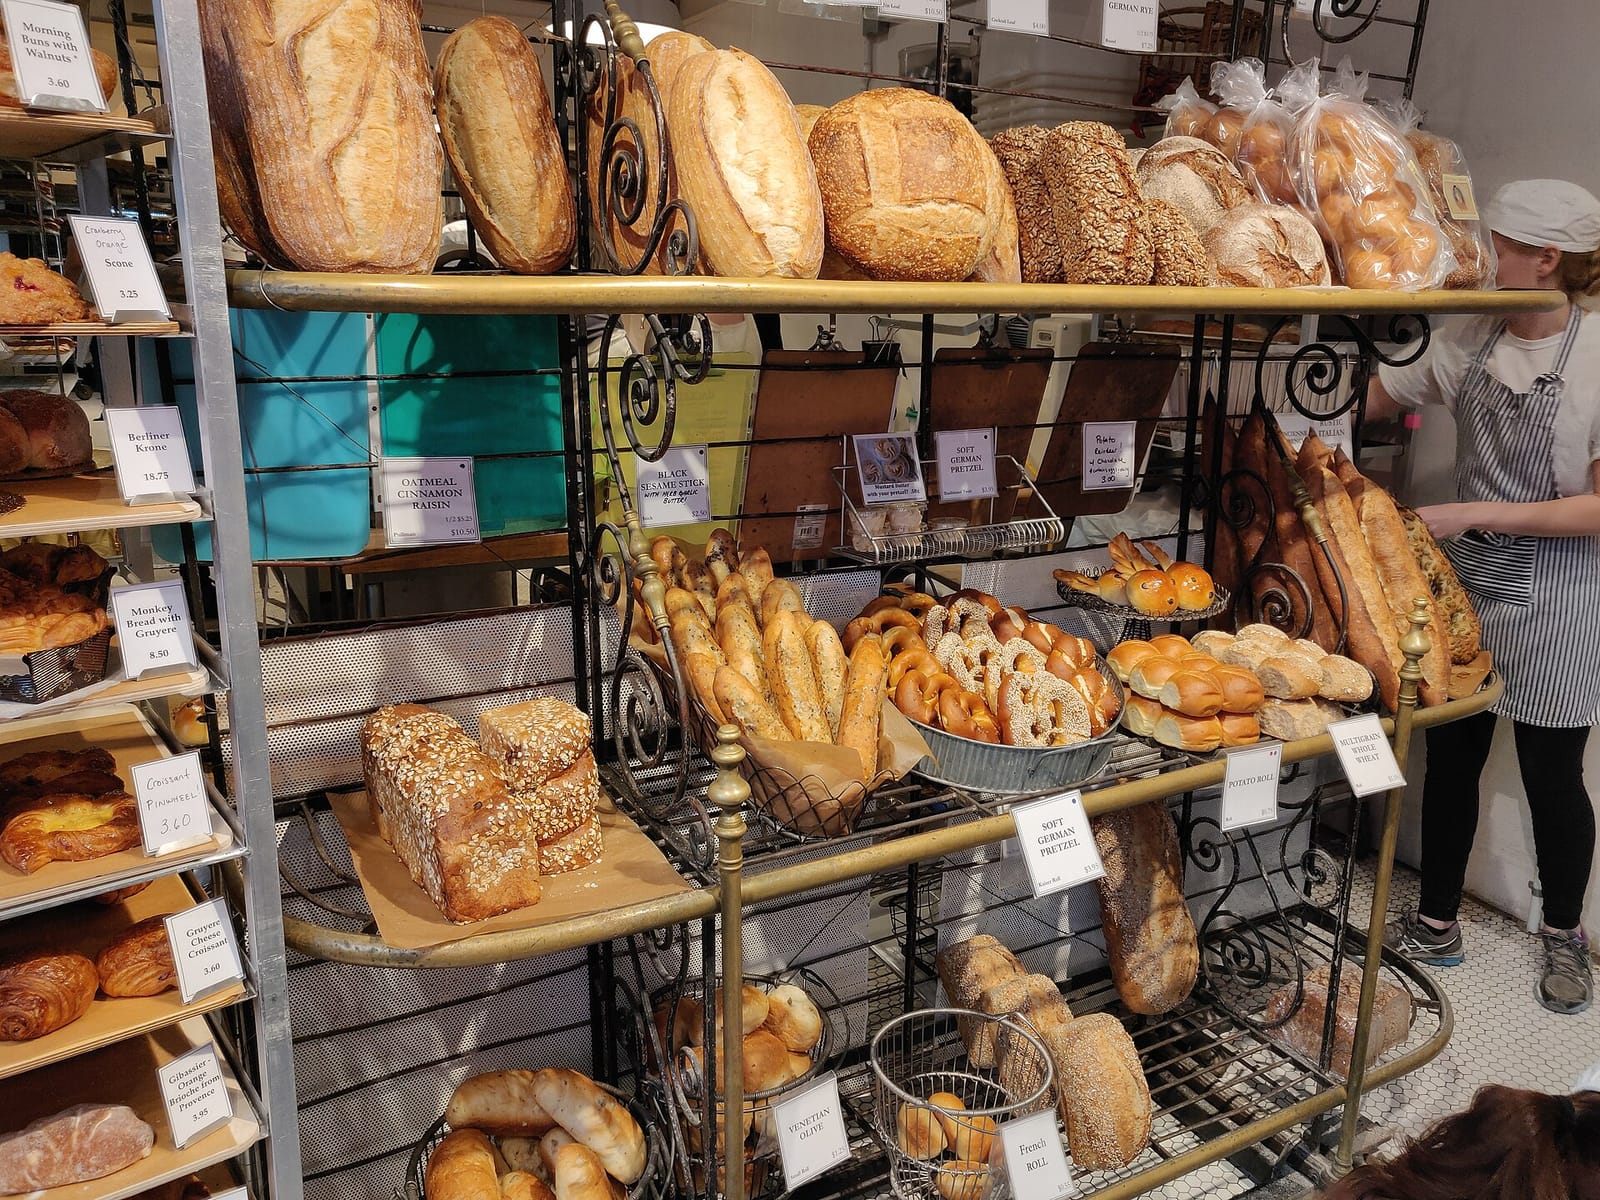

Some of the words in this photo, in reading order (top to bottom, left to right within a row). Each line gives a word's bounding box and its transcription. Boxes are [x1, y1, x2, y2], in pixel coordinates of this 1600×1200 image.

[924, 8, 943, 16] $10.50
[1108, 1, 1139, 13] GERMAN
[1139, 7, 1154, 15] RYE
[23, 22, 72, 41] Morning
[21, 34, 50, 47] Buns
[52, 40, 78, 52] with
[47, 77, 70, 88] 3.60
[95, 239, 128, 254] Orange
[104, 258, 134, 268] Scone
[119, 290, 139, 299] 3.25
[1319, 418, 1343, 427] RUSTIC
[128, 431, 170, 442] Berliner
[1319, 428, 1345, 437] ITALIAN
[135, 444, 167, 453] Krone
[956, 446, 975, 454] SOFT
[950, 454, 982, 464] GERMAN
[658, 469, 688, 479] BLACK
[950, 464, 984, 473] PRETZEL
[144, 471, 169, 481] 18.75
[401, 477, 457, 487] OATMEAL
[640, 480, 677, 491] SESAME
[678, 478, 705, 488] STICK
[397, 488, 463, 499] CINNAMON
[412, 501, 451, 510] RAISIN
[450, 527, 475, 537] $10.50
[131, 604, 173, 617] Monkey
[126, 616, 156, 628] Bread
[158, 613, 182, 624] with
[135, 627, 177, 639] Gruyere
[149, 649, 169, 659] 8.50
[1339, 731, 1382, 747] MULTIGRAIN
[1351, 743, 1377, 755] WHOLE
[1355, 752, 1381, 765] WHEAT
[146, 768, 191, 791] Croissant
[1228, 776, 1256, 789] POTATO
[1256, 773, 1274, 784] ROLL
[160, 813, 191, 835] 3.60
[1041, 817, 1064, 832] SOFT
[1037, 826, 1076, 845] GERMAN
[1040, 838, 1081, 857] PRETZEL
[186, 919, 221, 938] Gruyere
[190, 930, 221, 947] Cheese
[188, 937, 228, 959] Croissant
[203, 962, 221, 976] 3.60
[177, 1070, 208, 1091] Orange
[168, 1085, 200, 1107] Brioche
[200, 1074, 221, 1093] from
[178, 1088, 216, 1112] Provence
[192, 1107, 209, 1122] 3.95
[788, 1107, 831, 1134] VENETIAN
[799, 1122, 824, 1141] OLIVE
[1019, 1137, 1047, 1156] French
[1026, 1157, 1049, 1172] ROLL
